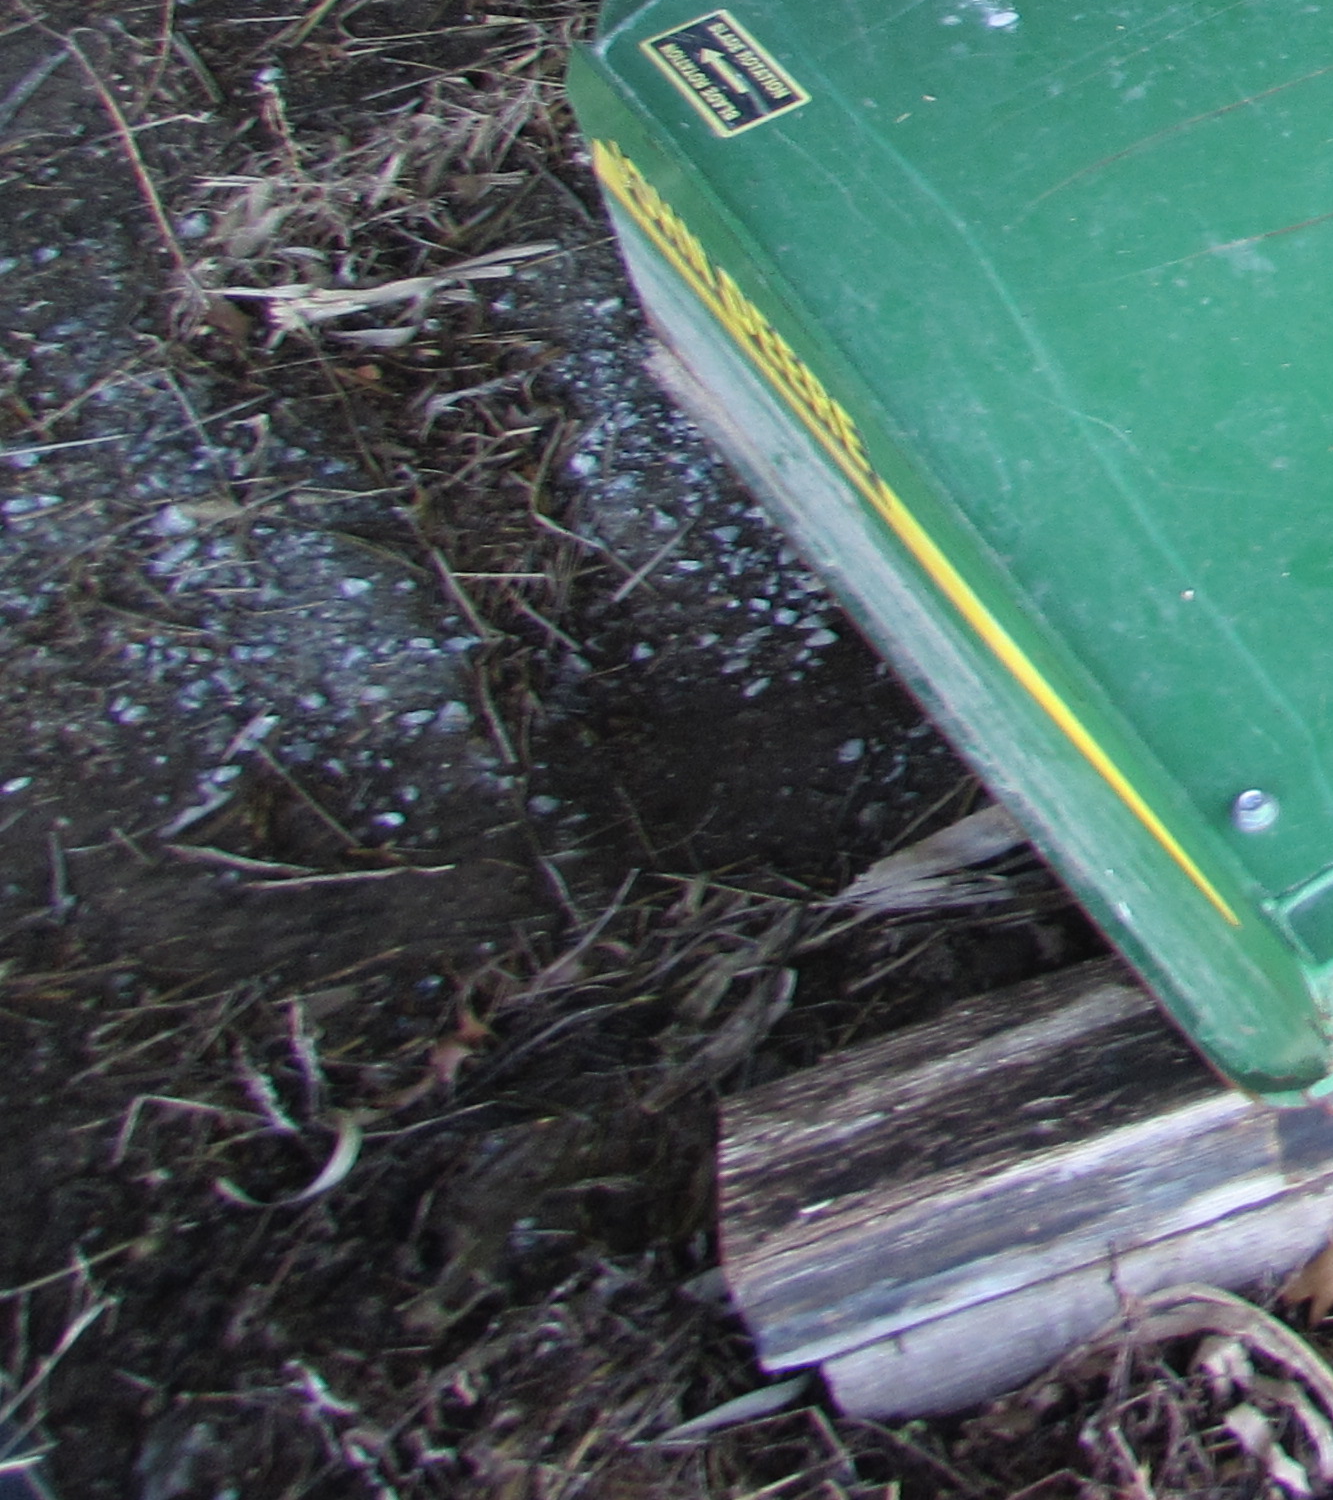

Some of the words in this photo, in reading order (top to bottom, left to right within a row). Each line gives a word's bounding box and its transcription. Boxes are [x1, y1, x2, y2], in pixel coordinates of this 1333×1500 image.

[658, 42, 713, 90] ROTATION
[707, 22, 747, 54] BLADE
[735, 50, 793, 100] ROTATION
[699, 85, 743, 122] BLADE
